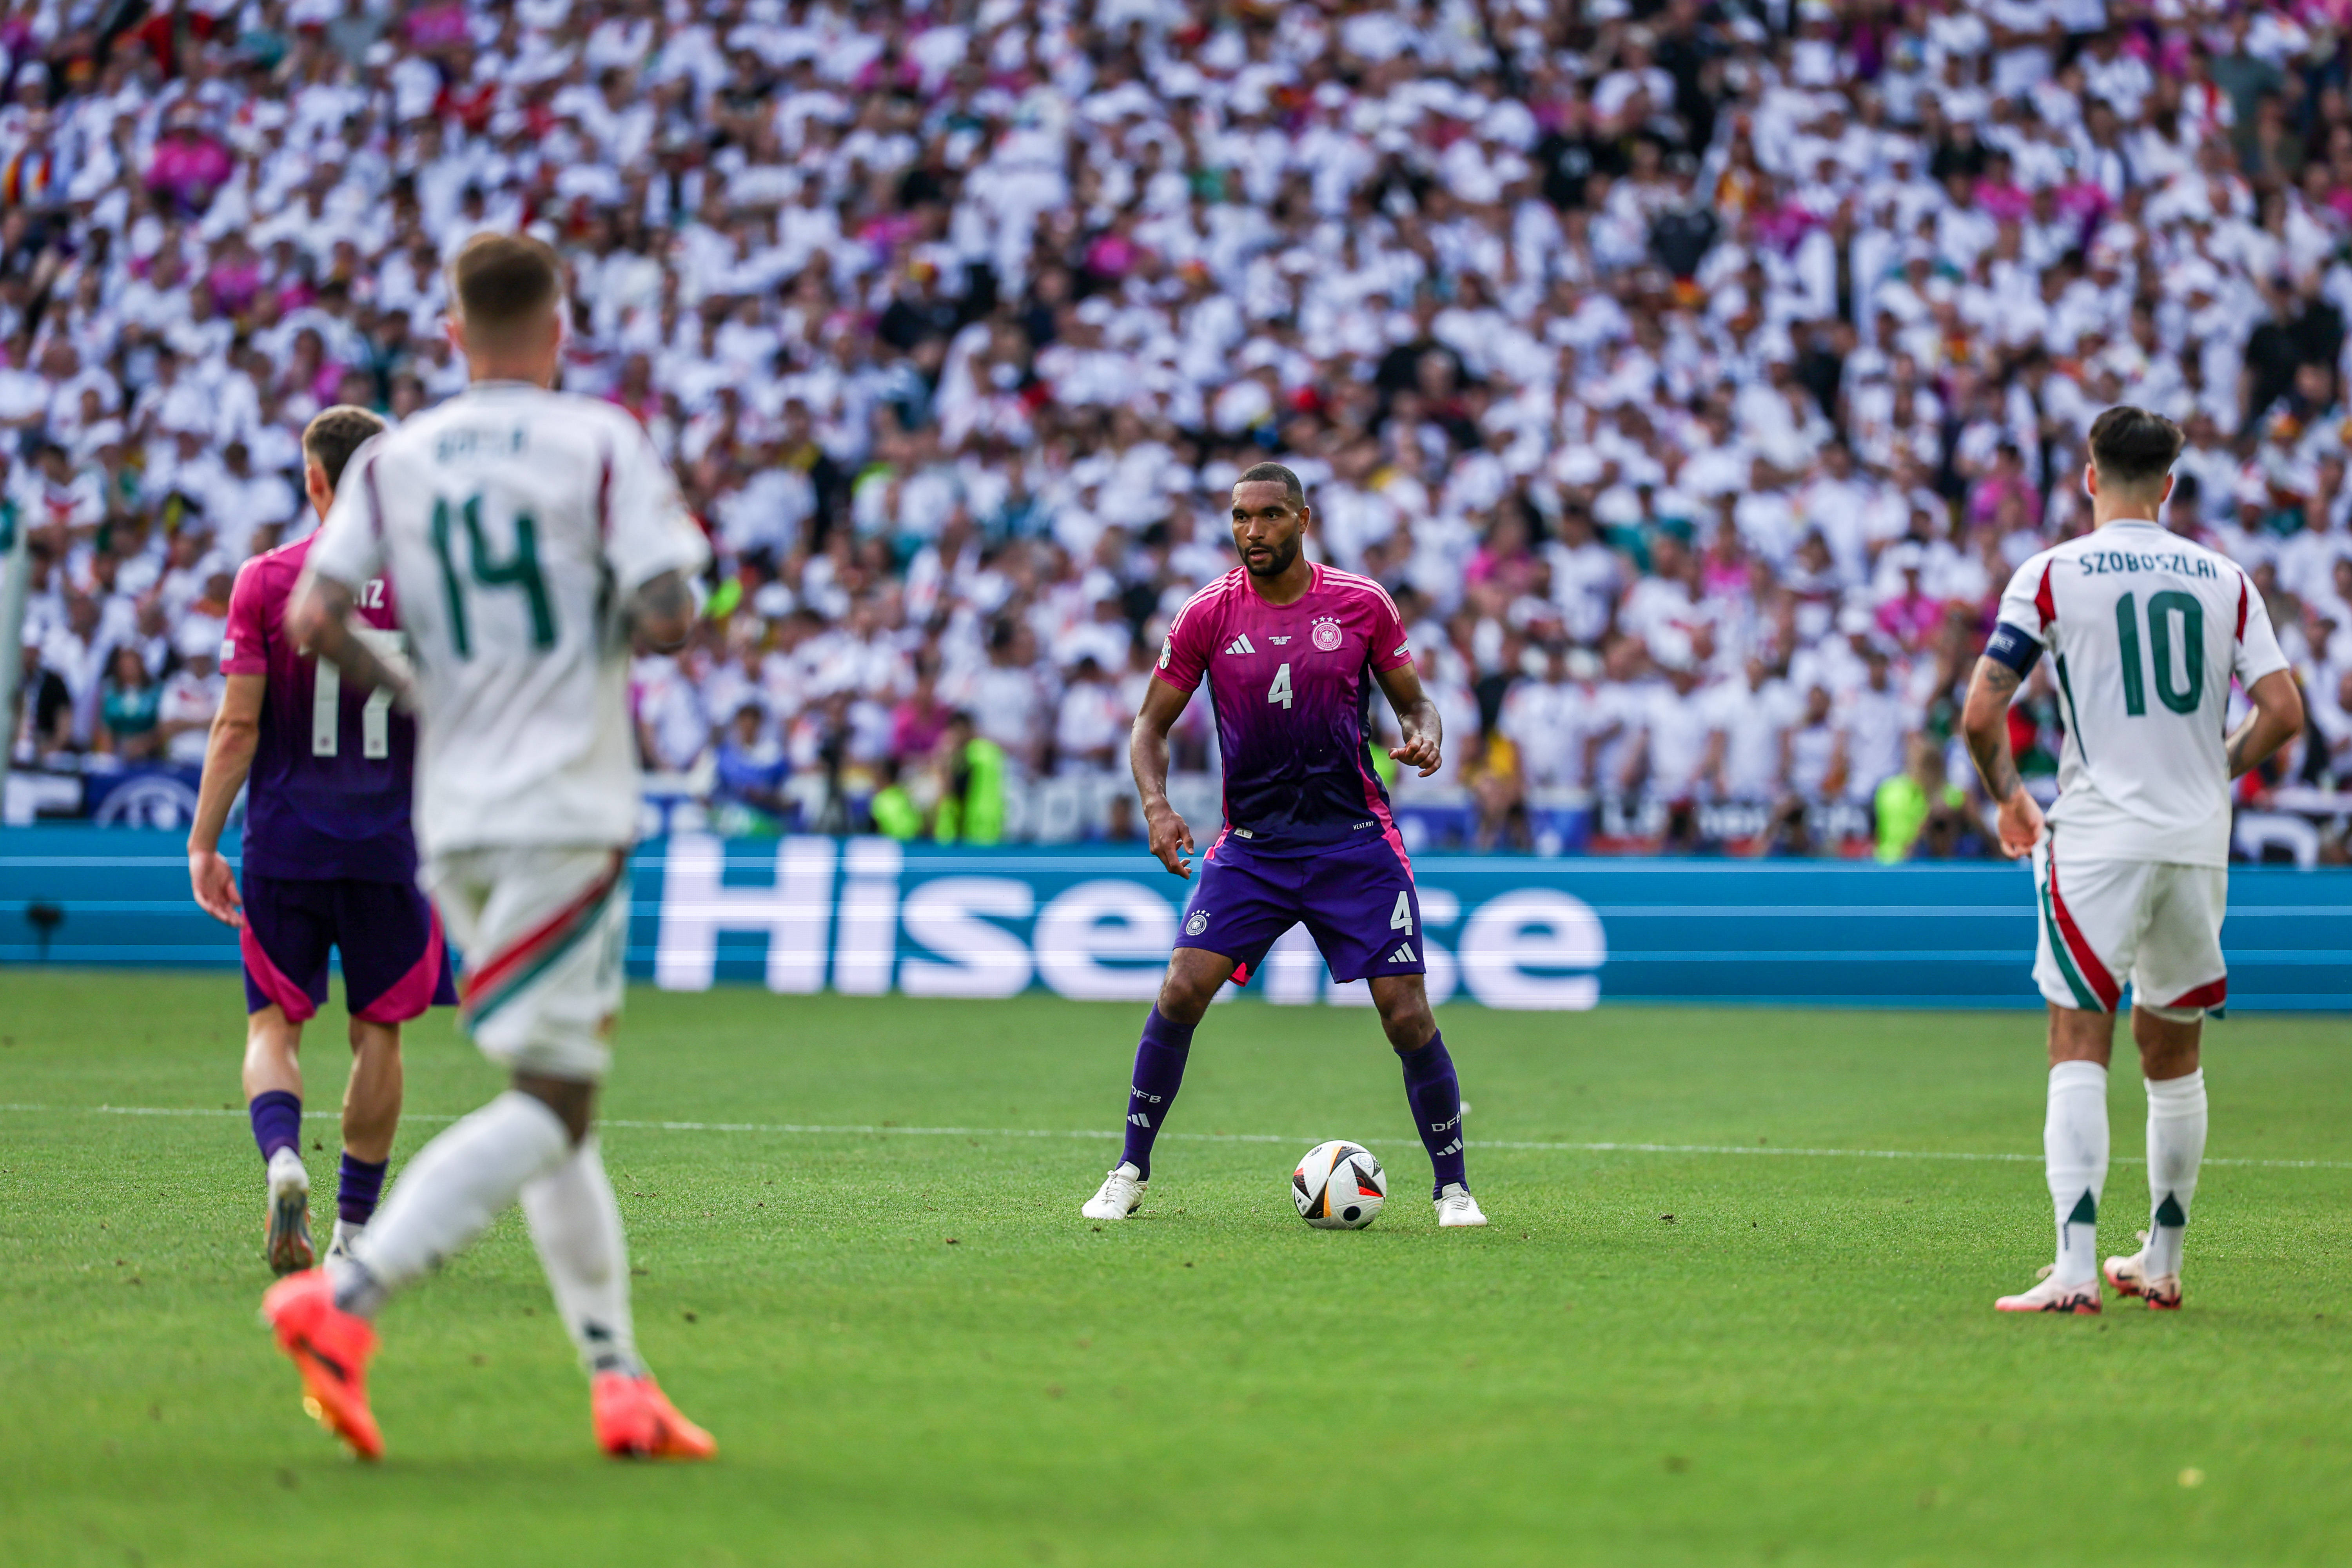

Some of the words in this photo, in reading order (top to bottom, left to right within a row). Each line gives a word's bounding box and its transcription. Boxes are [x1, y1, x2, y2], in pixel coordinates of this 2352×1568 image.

[430, 495, 556, 659] 14
[2079, 551, 2217, 580] SZOBOSZLAI
[2115, 589, 2204, 717] 10
[1268, 663, 1293, 709] 4
[1353, 820, 1374, 830] HEAT.RDY
[1390, 891, 1413, 936] 4
[1132, 1084, 1161, 1103] DFB
[1431, 1111, 1460, 1132] DFB
